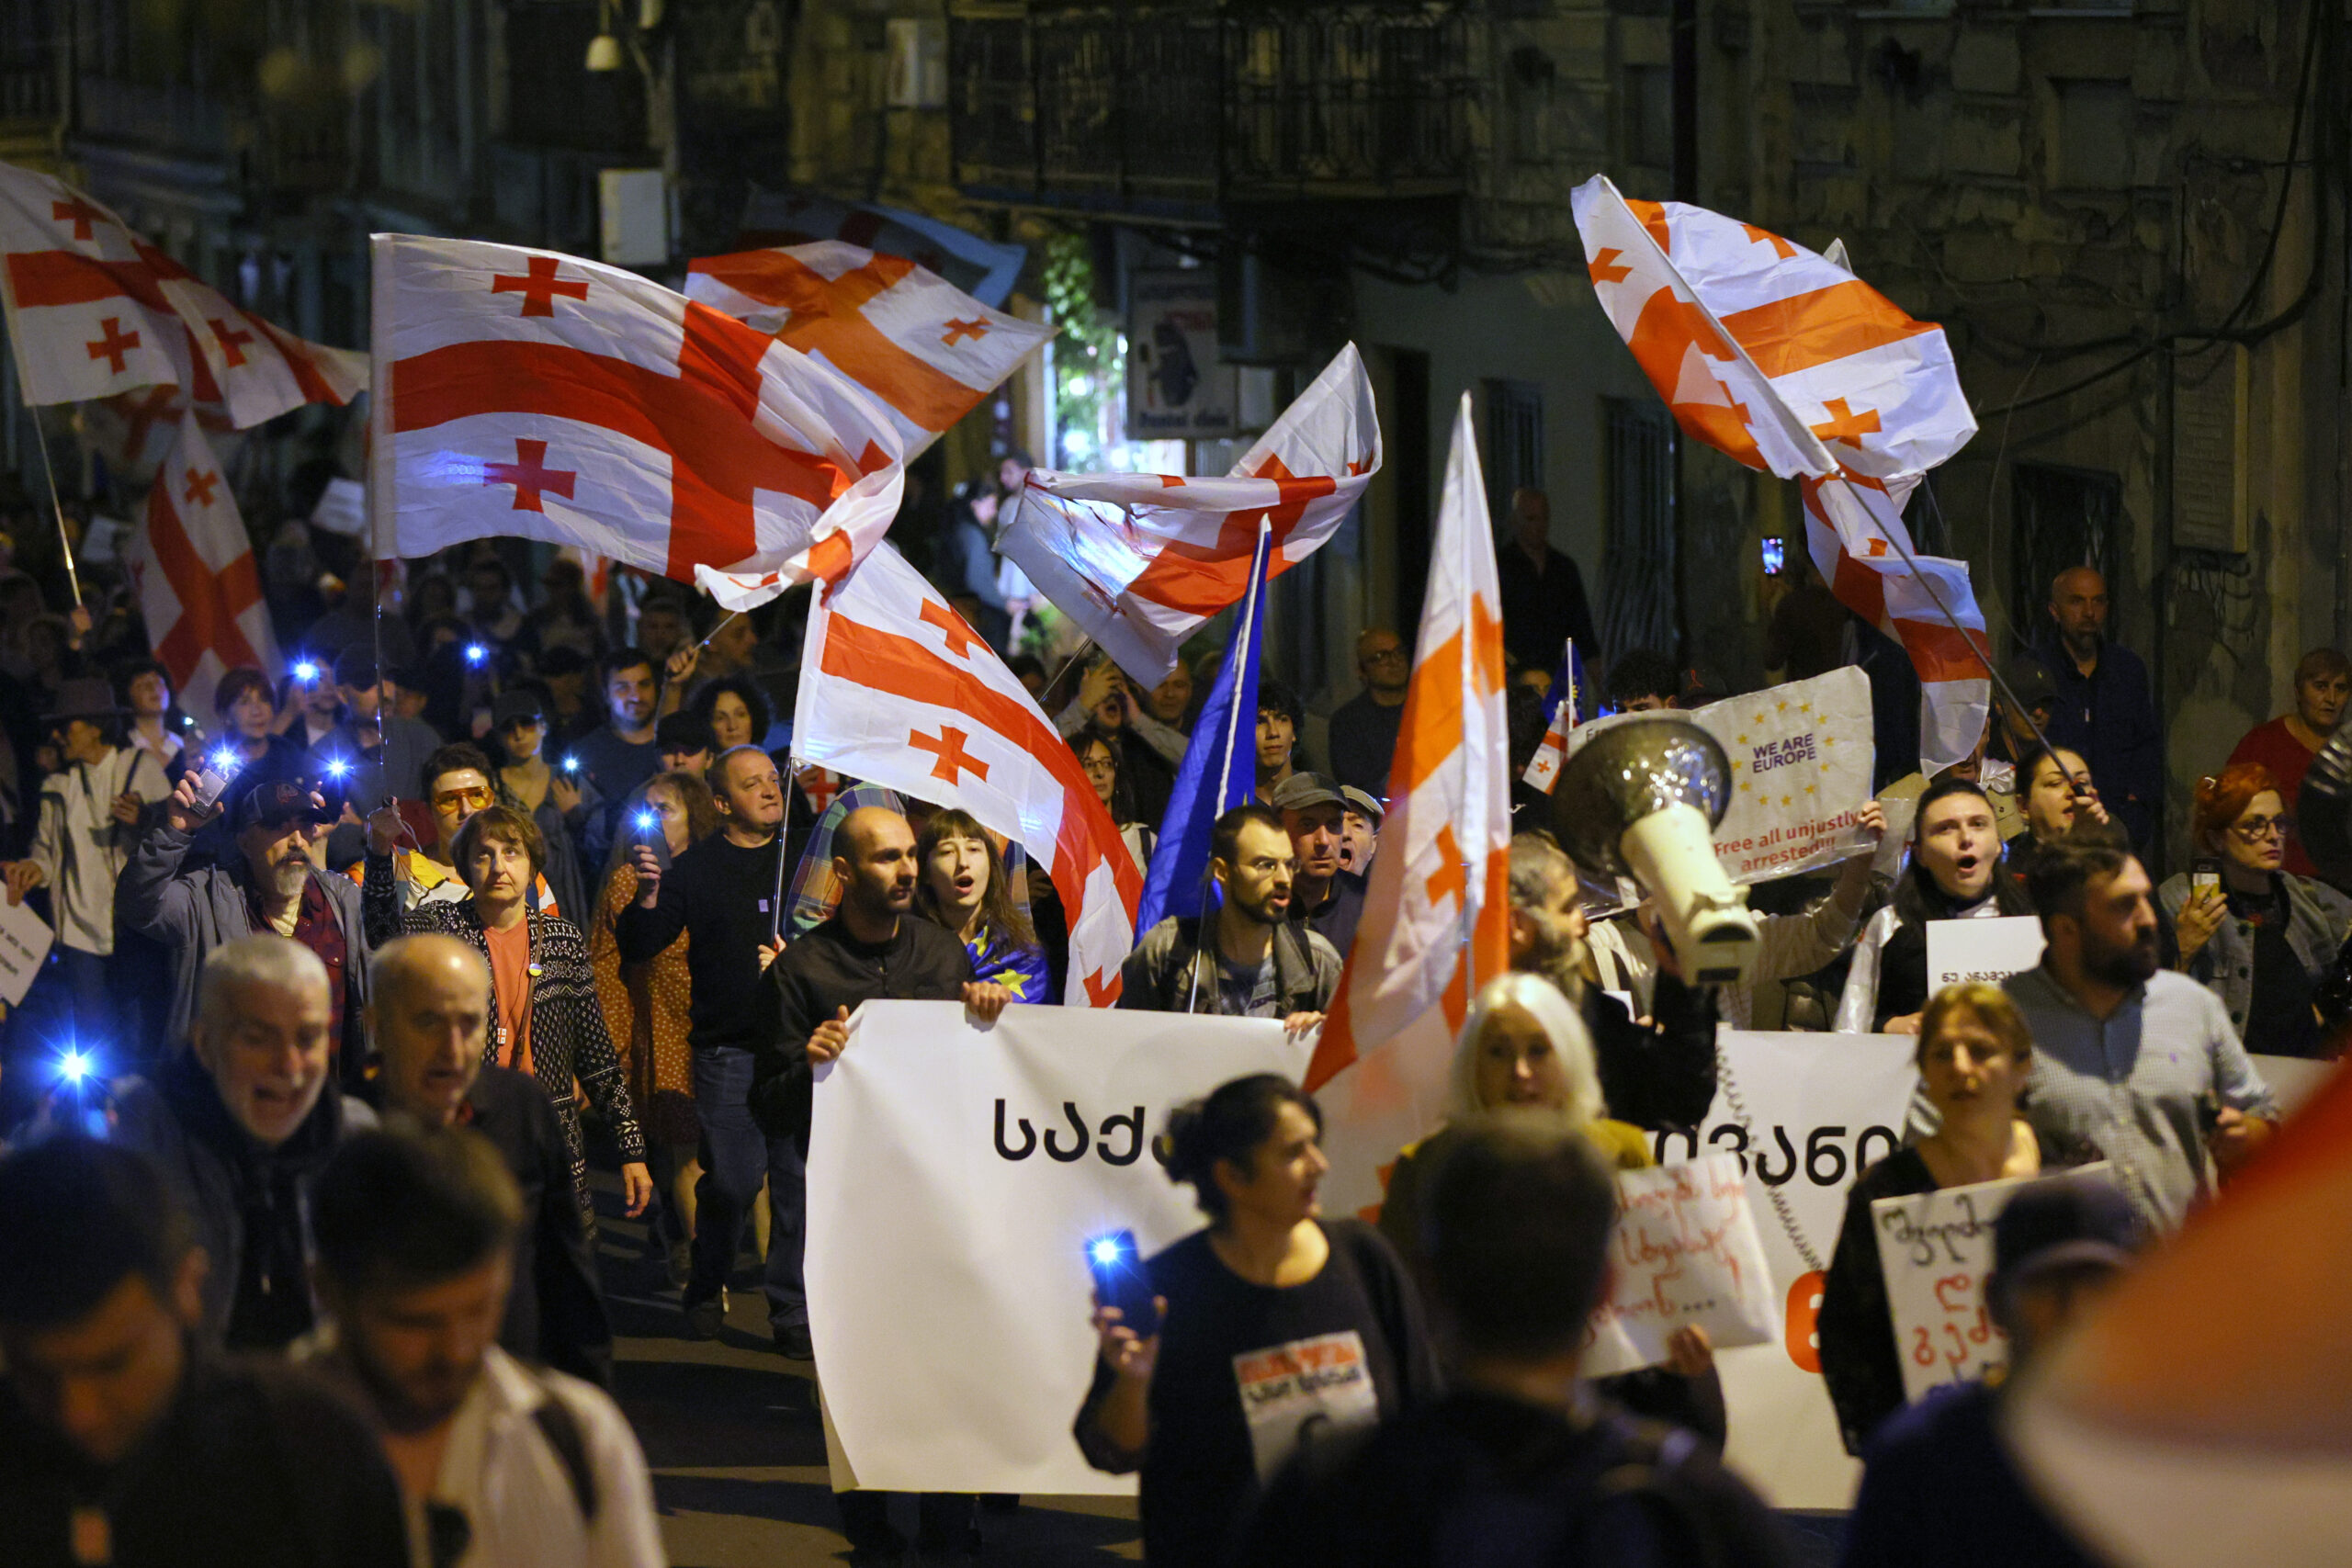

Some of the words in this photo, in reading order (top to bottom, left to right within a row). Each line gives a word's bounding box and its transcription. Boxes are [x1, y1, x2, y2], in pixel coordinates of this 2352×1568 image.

[1752, 746, 1816, 773] EUROPE
[1753, 741, 1778, 759] WE
[1781, 733, 1814, 752] ARE
[1713, 837, 1753, 857] Free
[1758, 828, 1781, 848] all
[1786, 810, 1859, 840] unjustly
